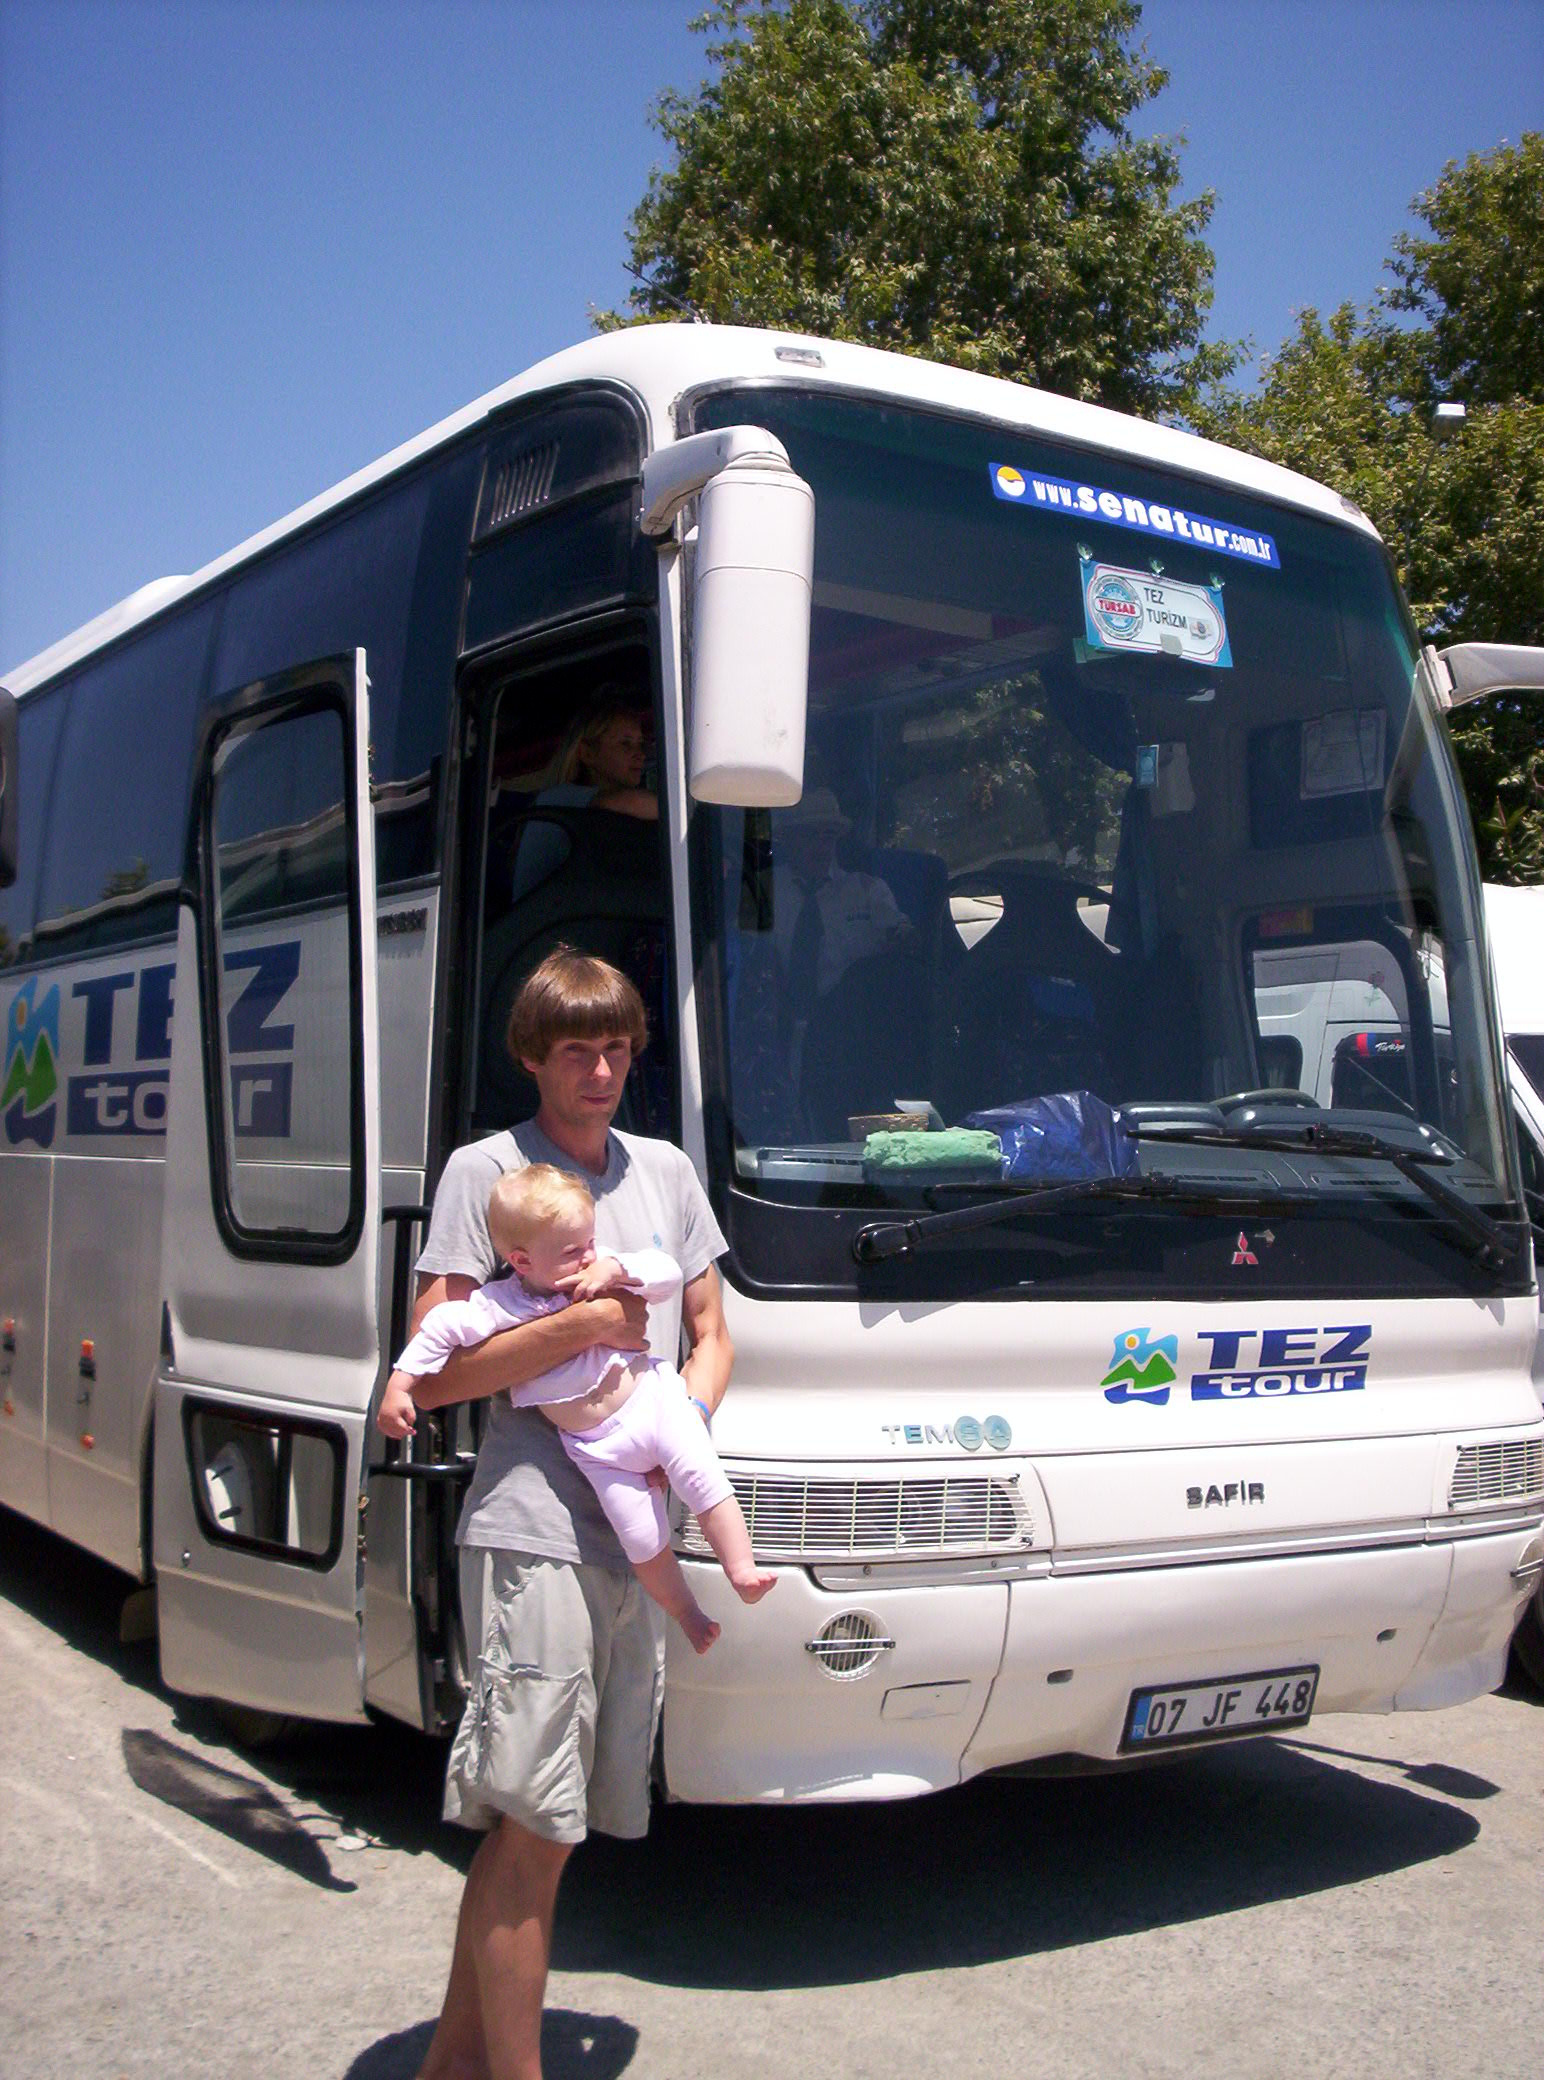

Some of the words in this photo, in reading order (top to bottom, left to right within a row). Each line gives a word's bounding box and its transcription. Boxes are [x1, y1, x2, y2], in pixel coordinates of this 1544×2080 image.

[1033, 480, 1271, 561] www.senatur.com.tr
[1143, 587, 1165, 605] TEZ
[85, 1079, 272, 1130] tor
[1197, 1325, 1373, 1370] TEZ
[1208, 1369, 1356, 1398] tour
[882, 1415, 1012, 1452] TEMSA
[1147, 1698, 1187, 1736] 07
[1203, 1690, 1241, 1727] JF
[1256, 1679, 1311, 1718] 448
